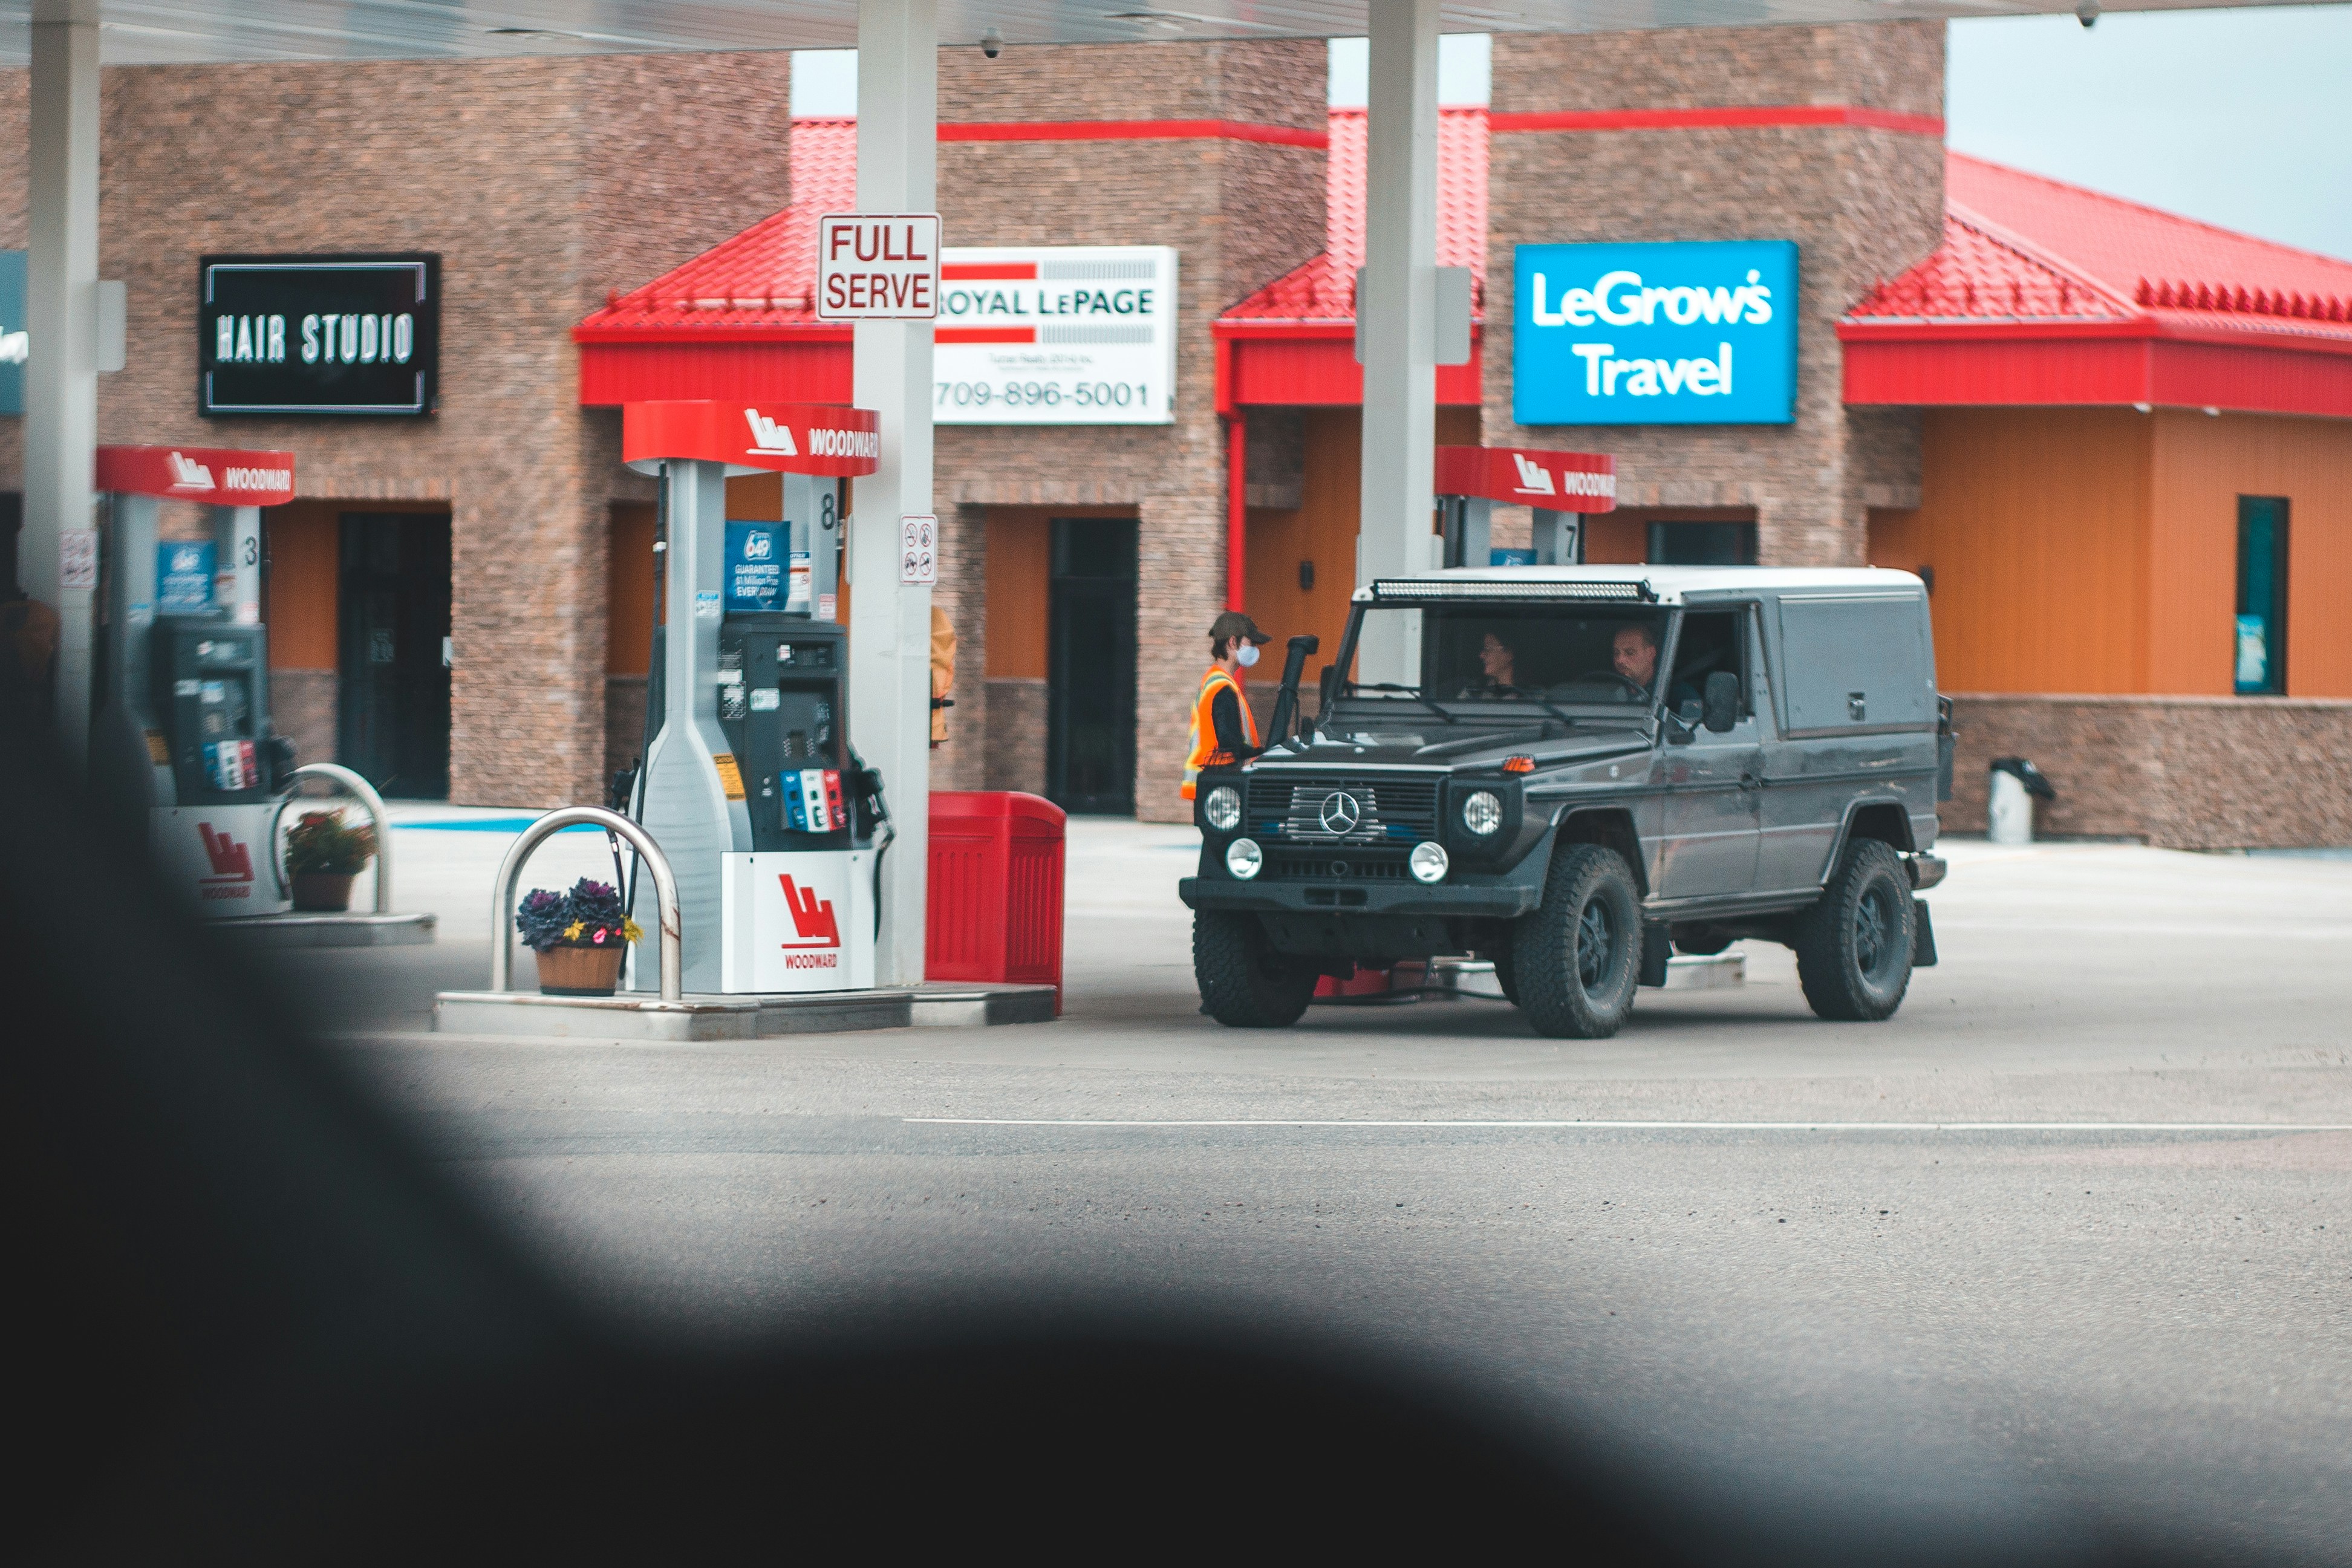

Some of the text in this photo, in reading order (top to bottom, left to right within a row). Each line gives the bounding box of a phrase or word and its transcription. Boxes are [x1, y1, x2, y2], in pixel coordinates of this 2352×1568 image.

[830, 225, 928, 261] FULL
[826, 273, 930, 308] SERVE
[1533, 269, 1773, 326] LeGrow's
[216, 313, 414, 364] HAIR STUDIO
[1572, 342, 1732, 396] Travel
[936, 381, 1147, 407] 709-896-5001
[226, 467, 291, 491] WOODWARD
[822, 493, 835, 530] 8
[245, 536, 257, 565] 3
[1566, 525, 1576, 558] 7
[735, 564, 780, 574] GUARANTEED
[737, 587, 759, 596] EVERY
[785, 954, 837, 969] WOODWARD
